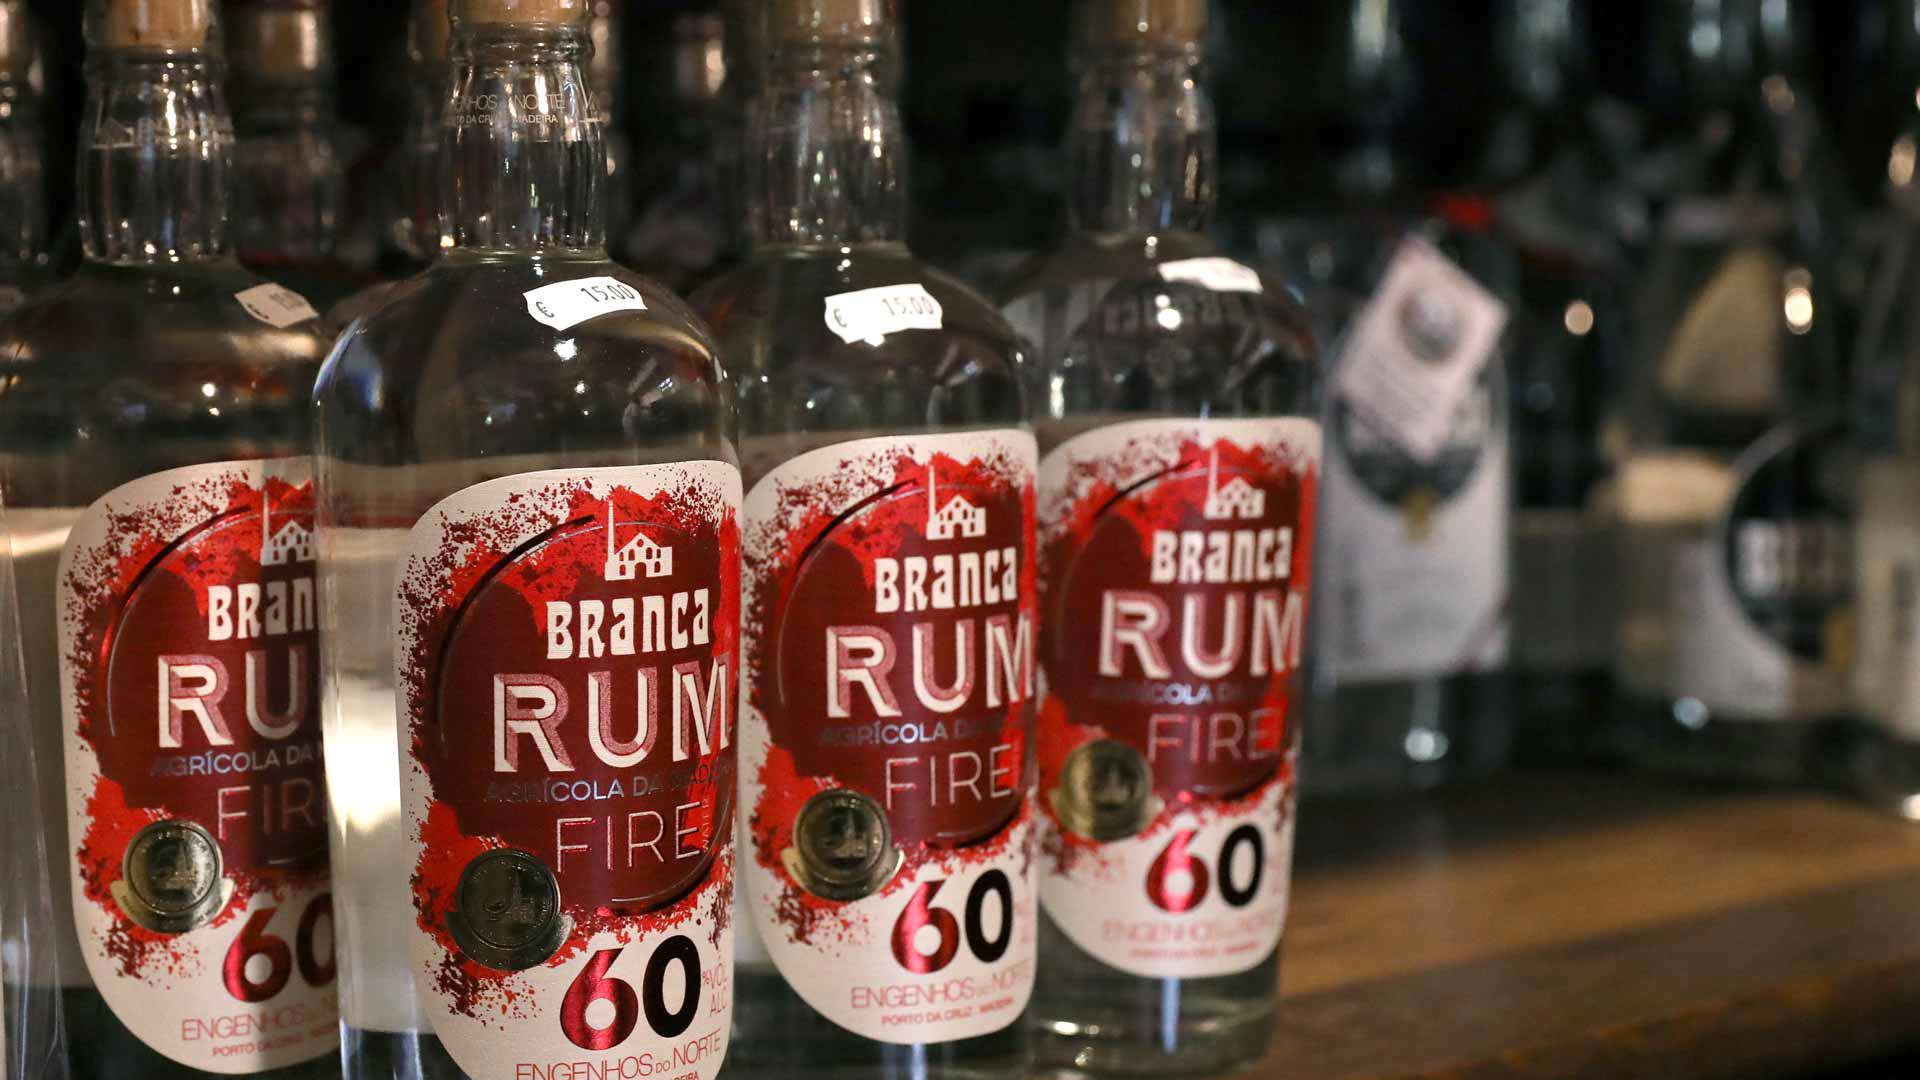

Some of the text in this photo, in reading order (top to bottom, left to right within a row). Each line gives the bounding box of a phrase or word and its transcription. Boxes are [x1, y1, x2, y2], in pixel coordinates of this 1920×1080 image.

[580, 284, 636, 302] 15.00
[826, 611, 1034, 718] RUM
[1100, 589, 1303, 679] RUM
[494, 652, 730, 772] RUM
[1147, 707, 1278, 763] FIRE
[886, 744, 1013, 810] FIRE
[557, 801, 701, 873] FIRE
[1145, 824, 1264, 914] 60
[222, 893, 337, 1003] 60
[890, 868, 1013, 974] 60
[560, 934, 701, 1050] 60
[851, 976, 976, 1009] ENGENHOS
[516, 1053, 653, 1080] ENGENHOS
[673, 1028, 721, 1068] NORTE
